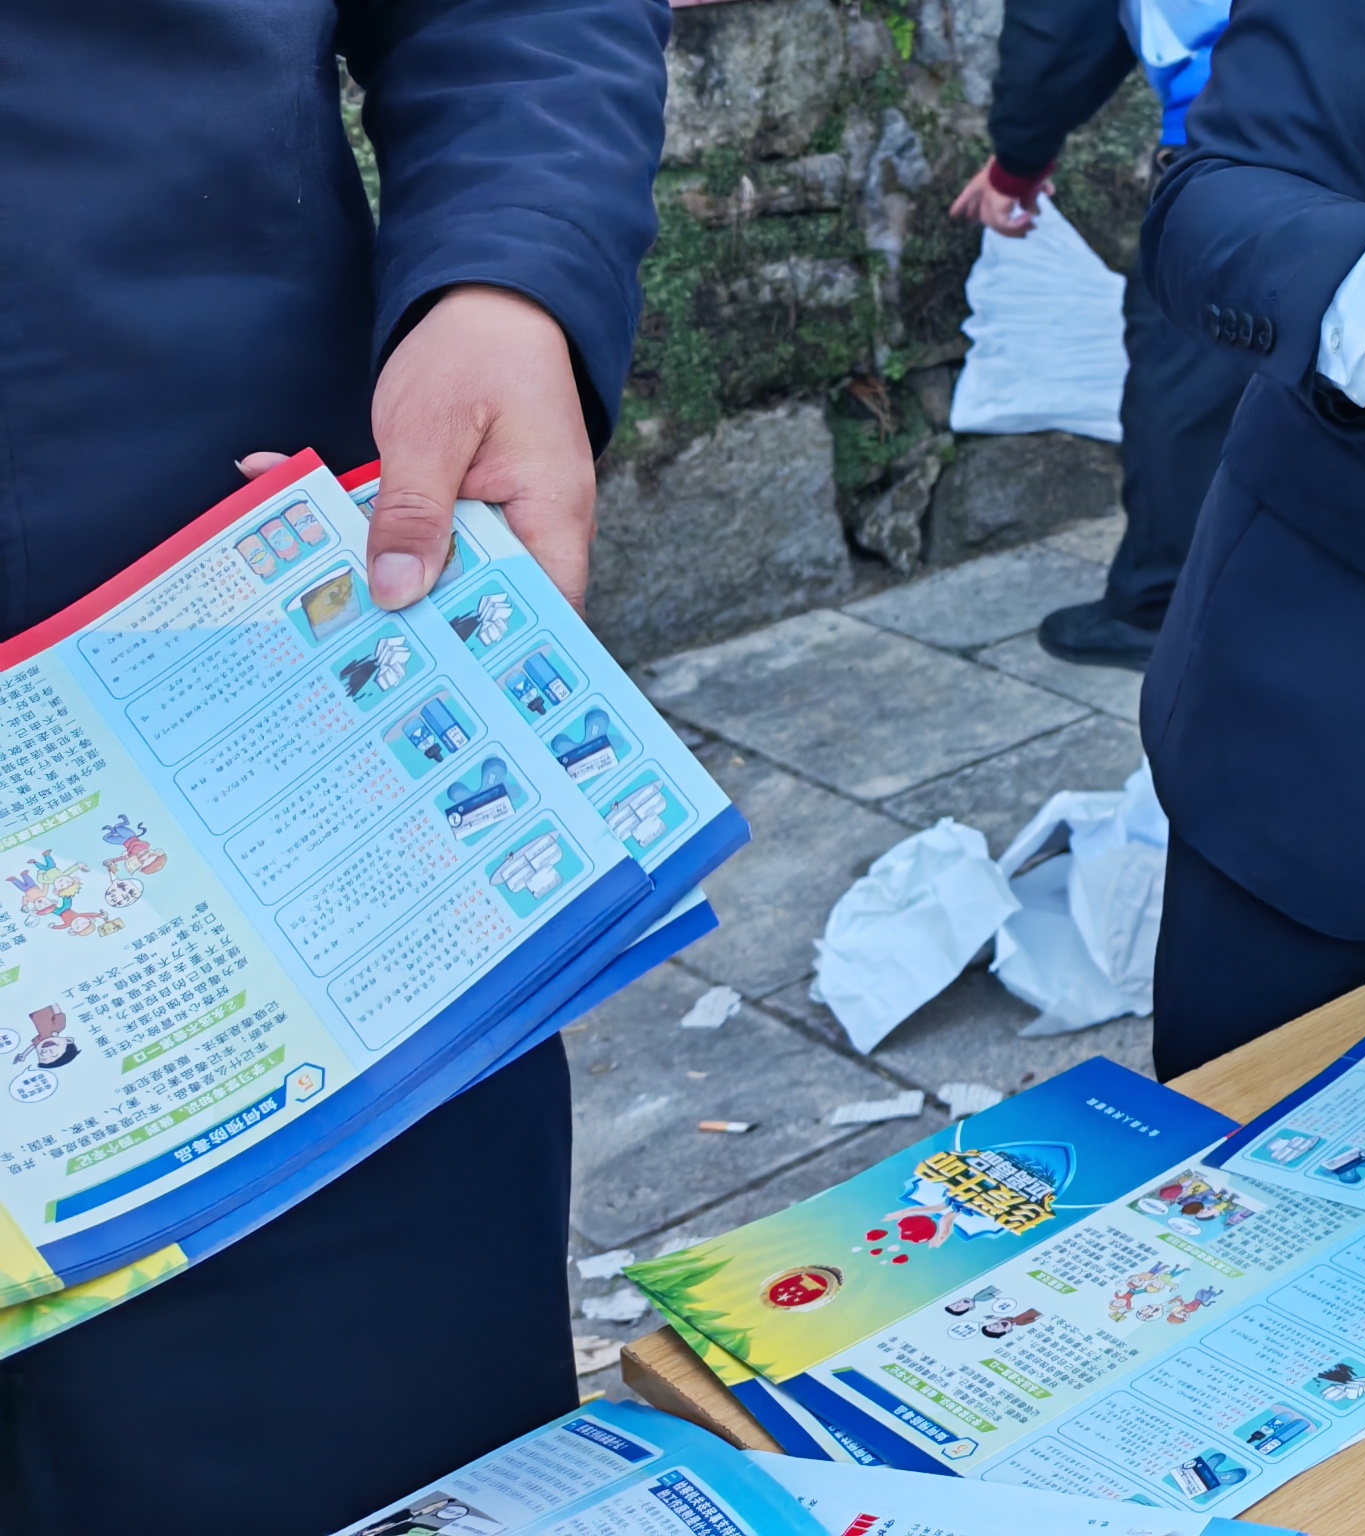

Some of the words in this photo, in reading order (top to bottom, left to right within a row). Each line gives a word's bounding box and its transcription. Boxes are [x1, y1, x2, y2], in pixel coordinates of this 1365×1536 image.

[0, 694, 63, 731] 渊。因此，
[6, 683, 55, 714] 身自好，
[6, 704, 70, 742] 身不由己，
[3, 783, 86, 831] 当前社会上一
[68, 919, 226, 1013] 味，千万不要相信“吸一
[76, 931, 233, 1026] 万不要去尝试吸毒的滋
[85, 942, 242, 1037] 提高自己的自控能力，千
[92, 953, 250, 1050] 成为毒品侵蚀的温床。要
[100, 982, 231, 1061] 好奇心和冒险心往往
[131, 1003, 228, 1066] 永远不尝第一口
[171, 1093, 279, 1166] 如何预防毒品
[893, 1401, 950, 1445] 如何预防毒品
